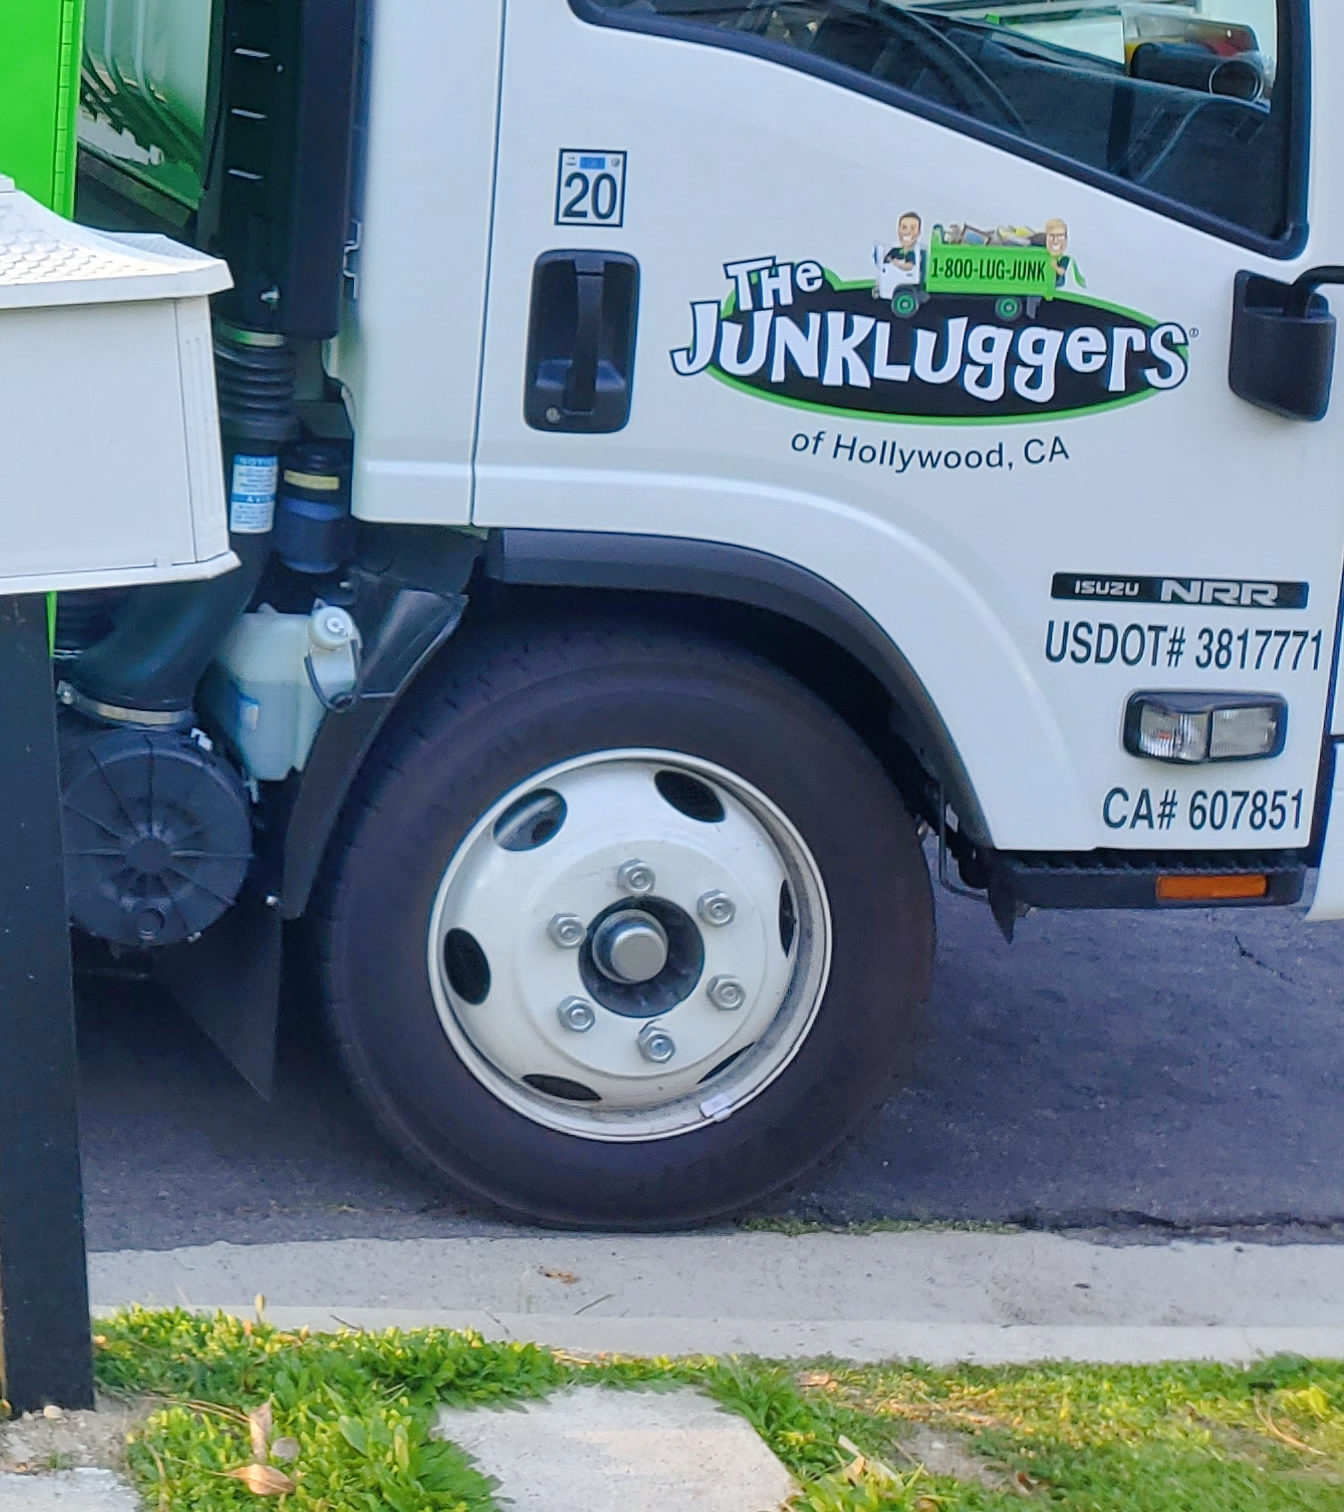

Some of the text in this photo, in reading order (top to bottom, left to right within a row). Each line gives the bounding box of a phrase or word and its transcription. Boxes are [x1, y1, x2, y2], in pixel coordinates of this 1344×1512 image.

[563, 172, 618, 220] 20
[931, 257, 1046, 282] 1-800-LUG-JUNK
[791, 431, 1070, 473] of Hollywood, CA
[1075, 579, 1279, 606] ISUZU NRR
[1045, 620, 1323, 671] USDOT# 3817771
[1103, 787, 1304, 831] CA# 607851
